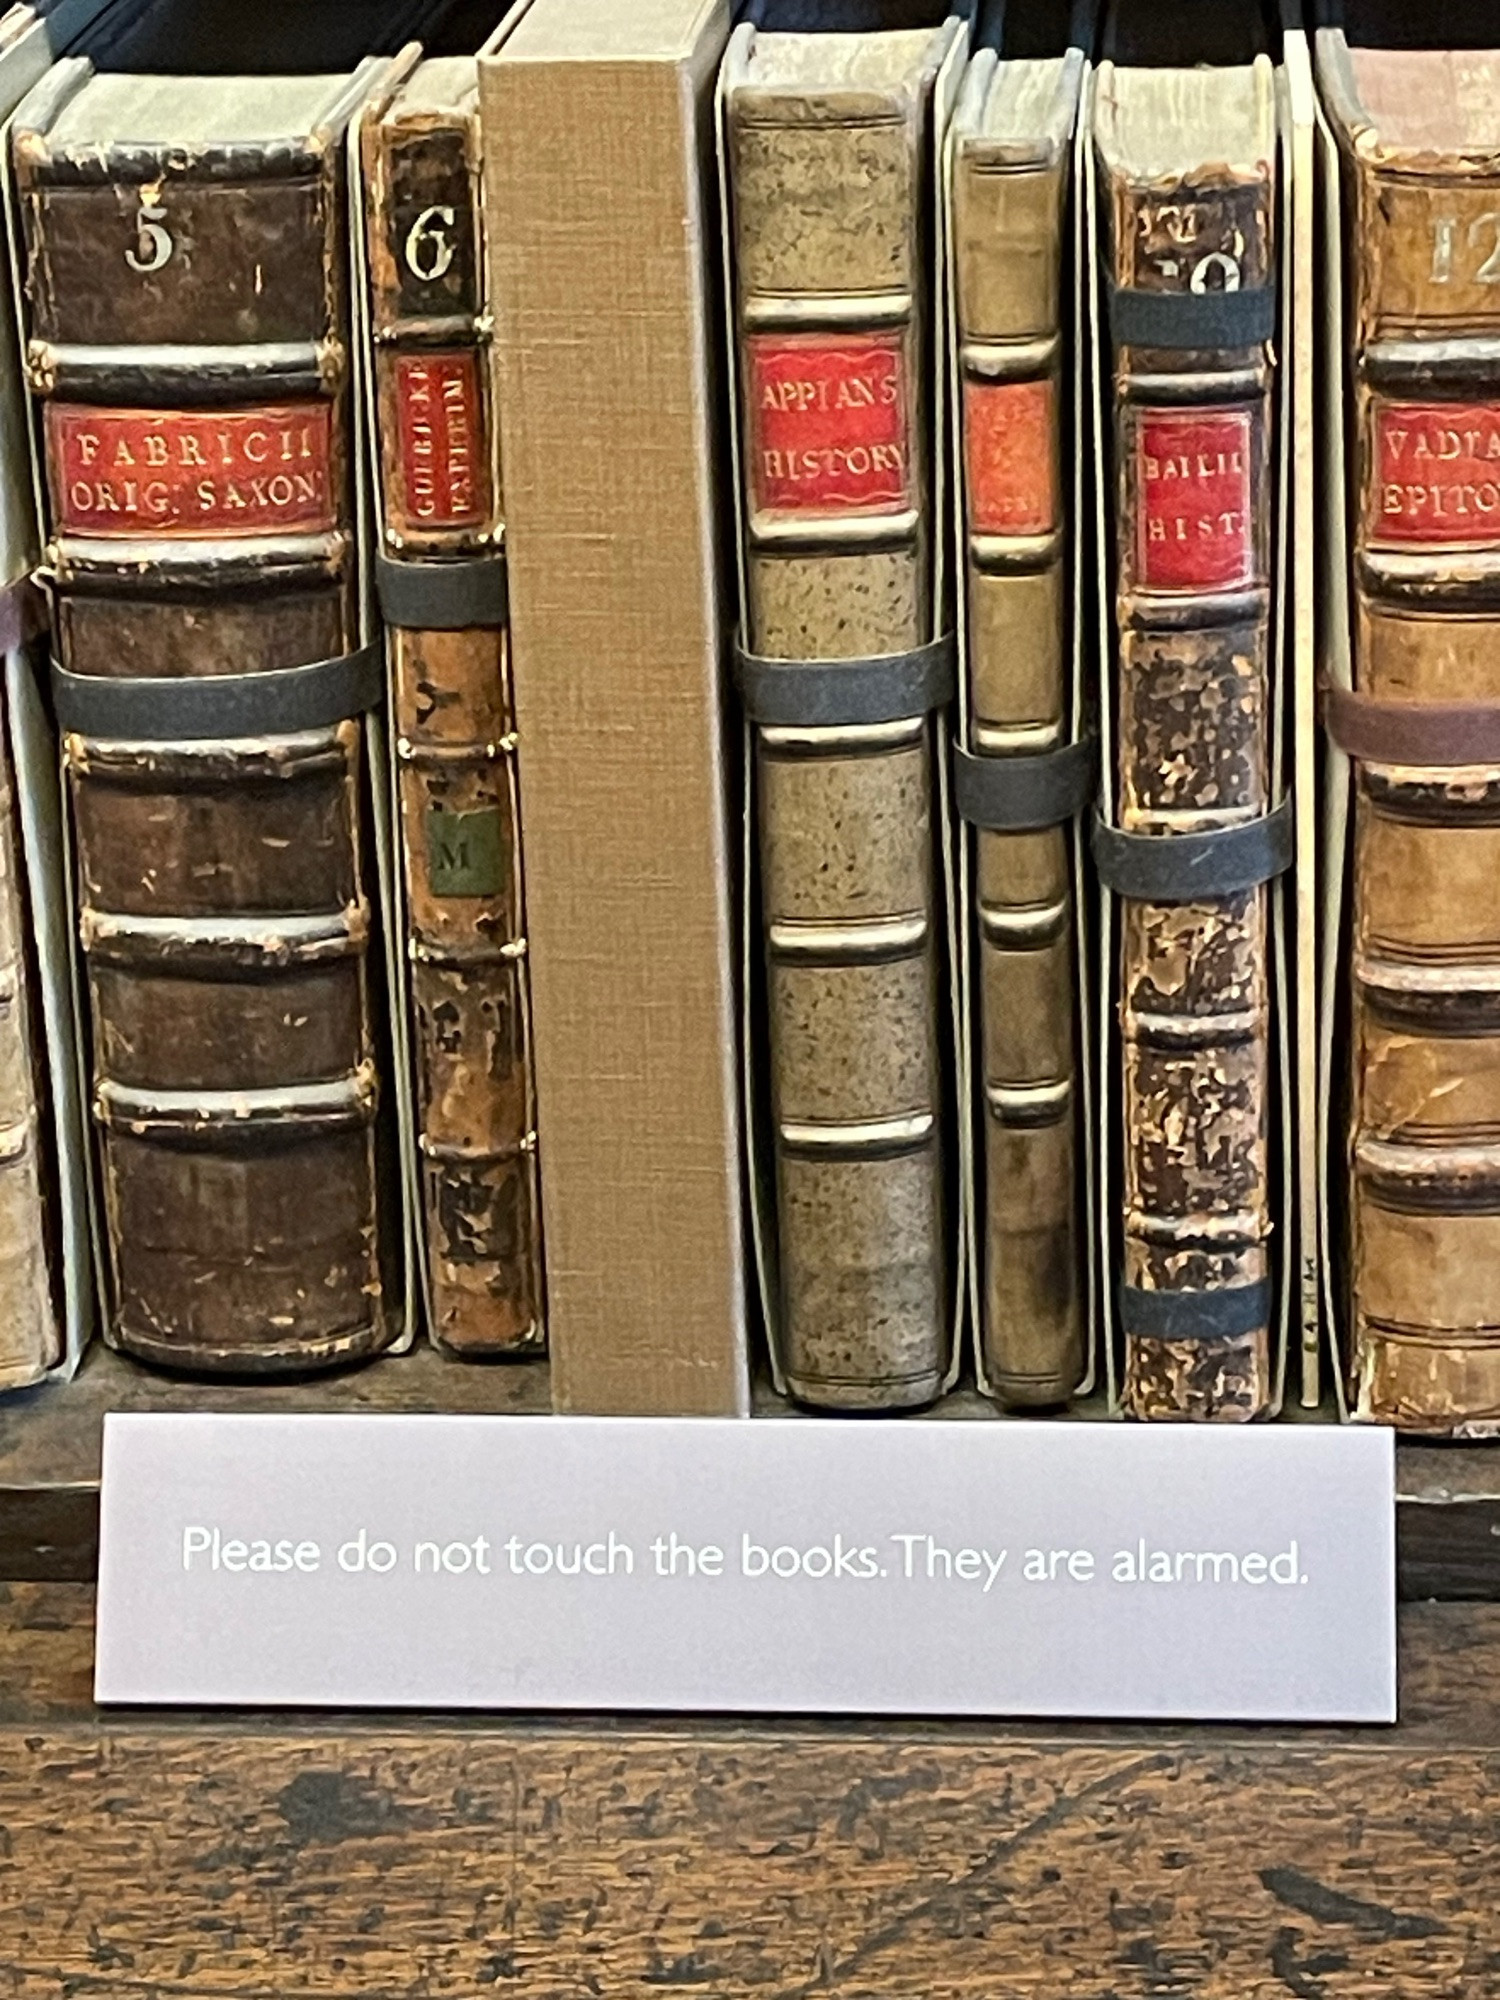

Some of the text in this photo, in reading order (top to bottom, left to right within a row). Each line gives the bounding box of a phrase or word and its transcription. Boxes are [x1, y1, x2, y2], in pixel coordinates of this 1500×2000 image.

[125, 206, 173, 272] 5
[405, 205, 455, 281] 6
[1427, 211, 1500, 284] 12
[76, 427, 312, 467] FABRICII
[763, 441, 906, 481] HISTORY
[437, 841, 470, 870] M
[182, 1526, 1310, 1594] Please do not touch the books. They are alarmed.
